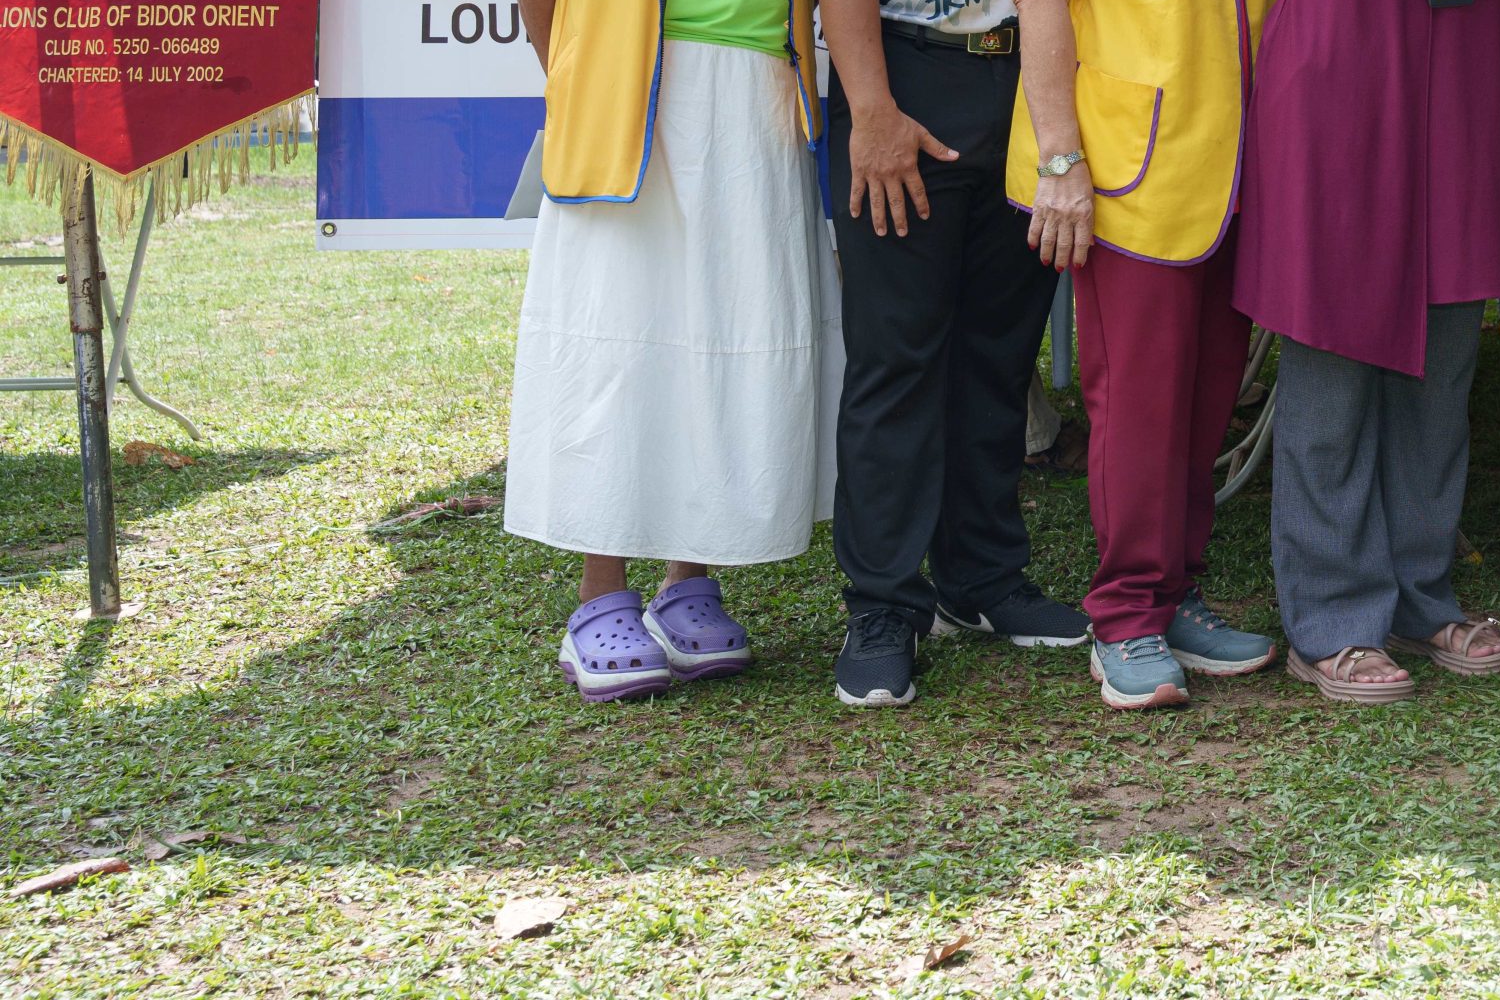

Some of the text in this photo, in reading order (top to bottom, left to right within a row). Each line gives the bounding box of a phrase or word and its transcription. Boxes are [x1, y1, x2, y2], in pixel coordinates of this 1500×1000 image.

[53, 6, 101, 29] CLUB
[106, 5, 131, 27] OF
[137, 4, 196, 27] BIDOR
[202, 5, 280, 28] ORIENT
[421, 2, 532, 44] LOU
[44, 39, 81, 56] CLUB
[85, 38, 108, 56] NO.
[38, 66, 224, 84] CHARTERED: 14 JULY 2002
